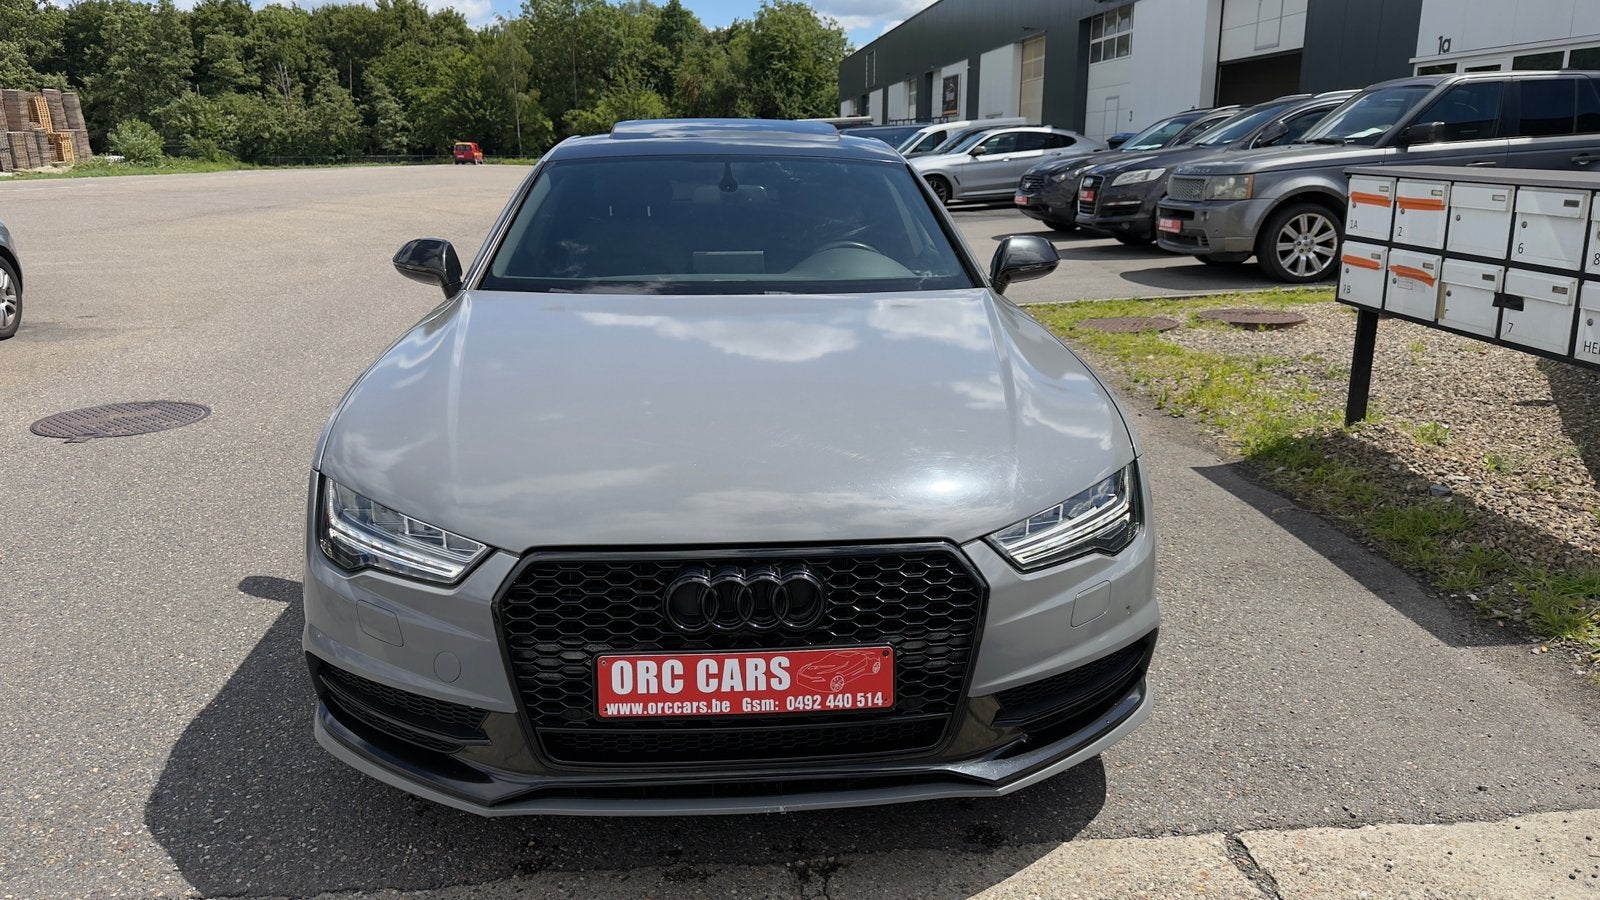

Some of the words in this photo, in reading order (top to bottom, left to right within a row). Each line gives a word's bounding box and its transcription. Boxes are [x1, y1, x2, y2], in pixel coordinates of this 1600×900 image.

[1438, 35, 1451, 55] 1a
[1349, 219, 1358, 229] 1A
[1397, 226, 1403, 237] 2
[1518, 242, 1524, 254] 6
[1507, 322, 1514, 333] 7
[1583, 340, 1600, 355] HE
[611, 659, 684, 695] ORC
[696, 656, 791, 693] CARS
[607, 697, 730, 715] www.orccars.be
[742, 697, 779, 712] Gsm:
[786, 695, 821, 710] 0492
[825, 693, 852, 709] 440
[856, 691, 883, 707] 514
